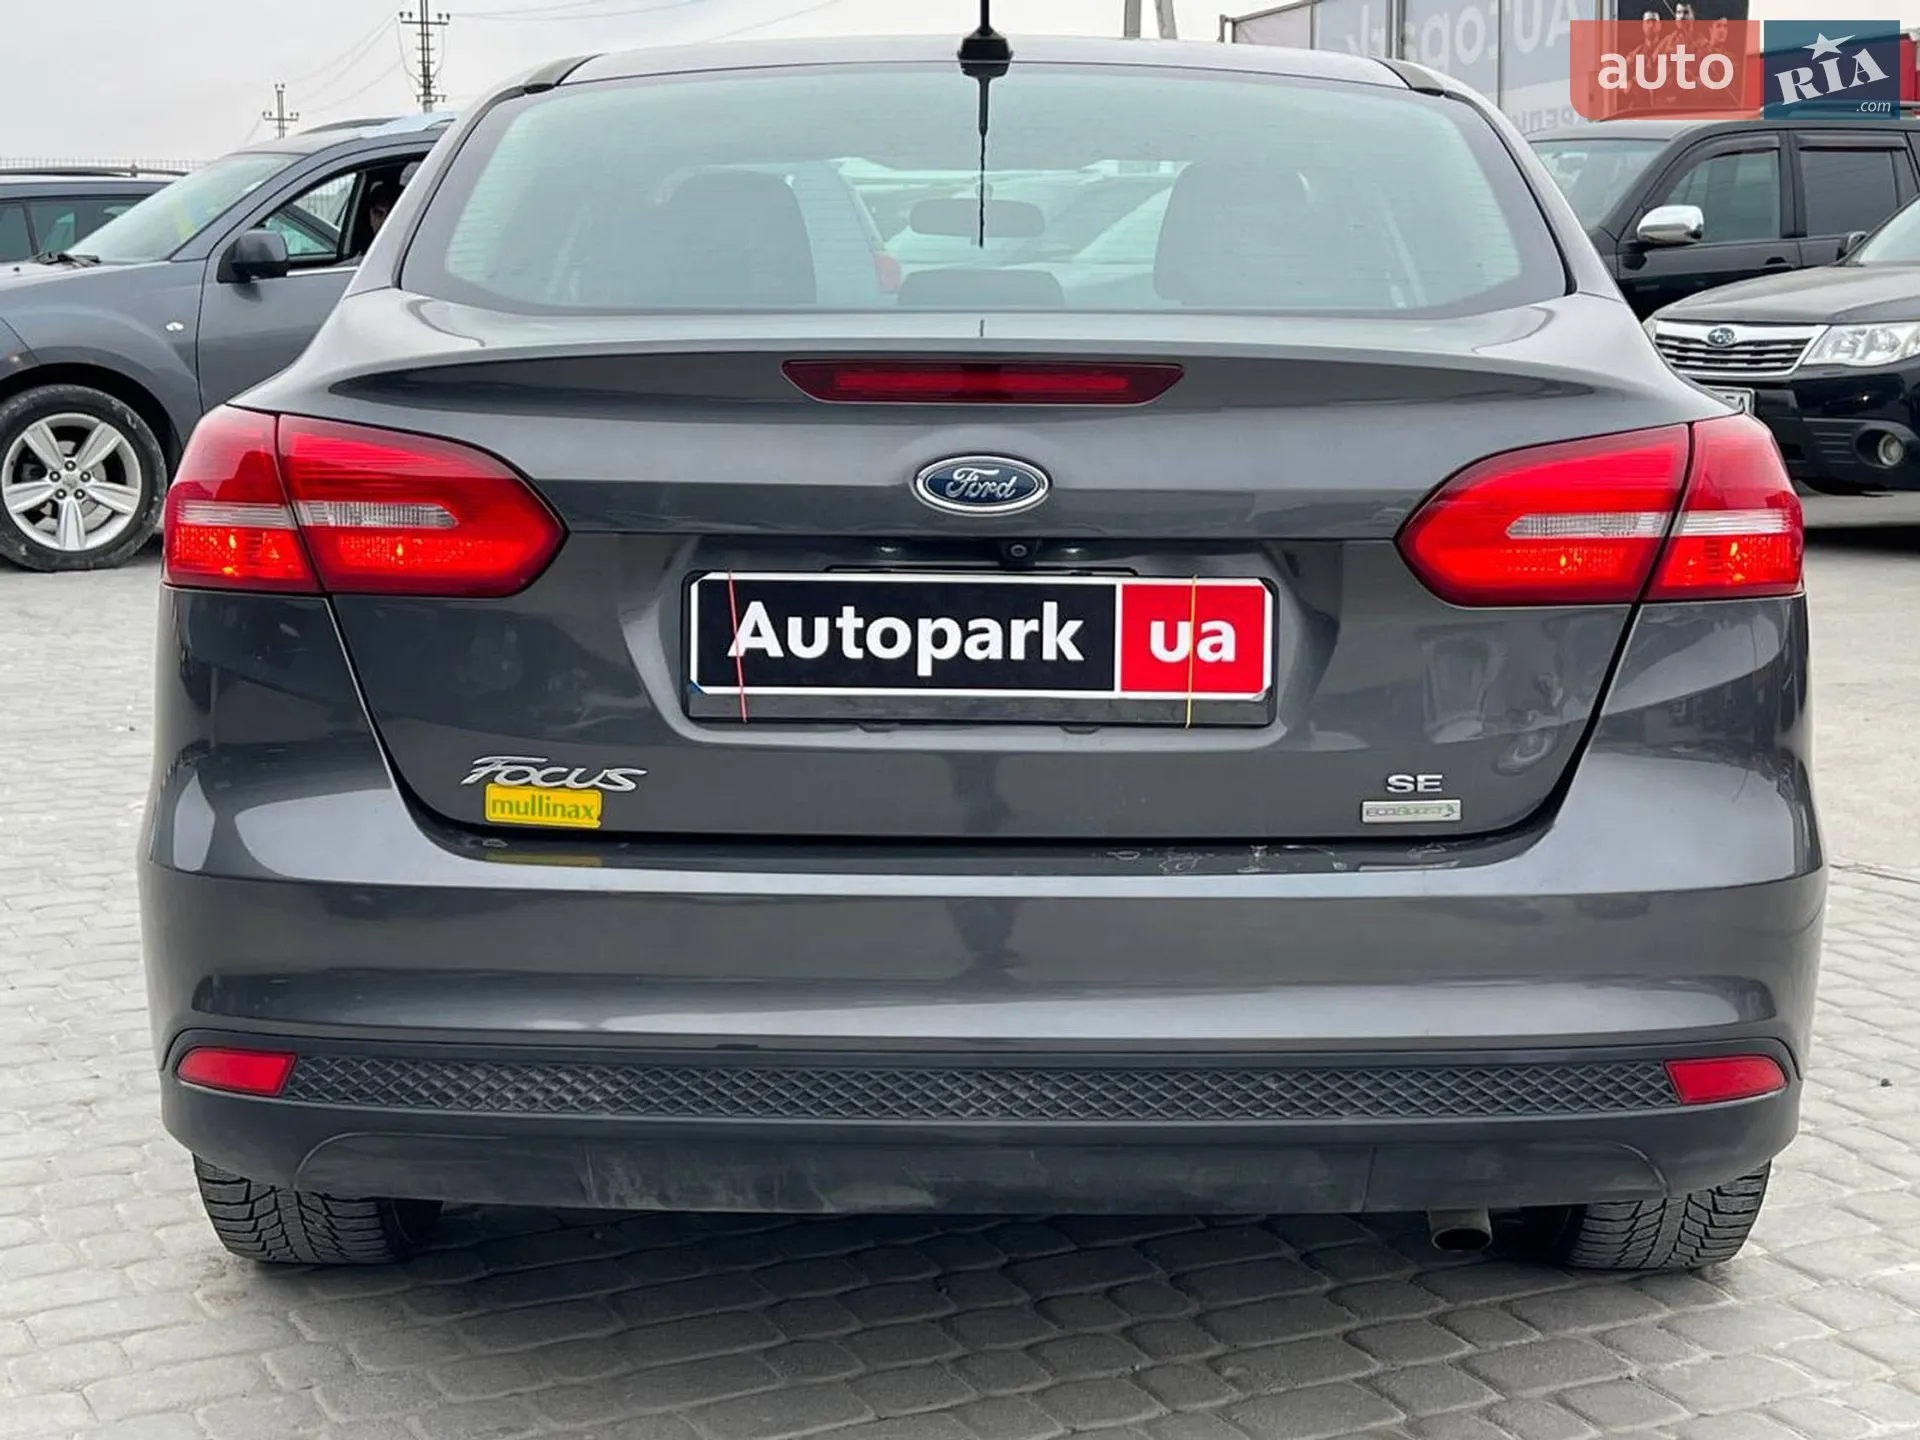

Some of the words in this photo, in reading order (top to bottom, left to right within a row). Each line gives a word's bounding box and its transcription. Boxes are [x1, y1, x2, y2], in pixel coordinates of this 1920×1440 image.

[946, 467, 1018, 498] Ford
[727, 600, 1085, 677] Autopark
[1149, 620, 1237, 664] ua
[1386, 774, 1443, 793] SE
[491, 794, 595, 820] mullinax
